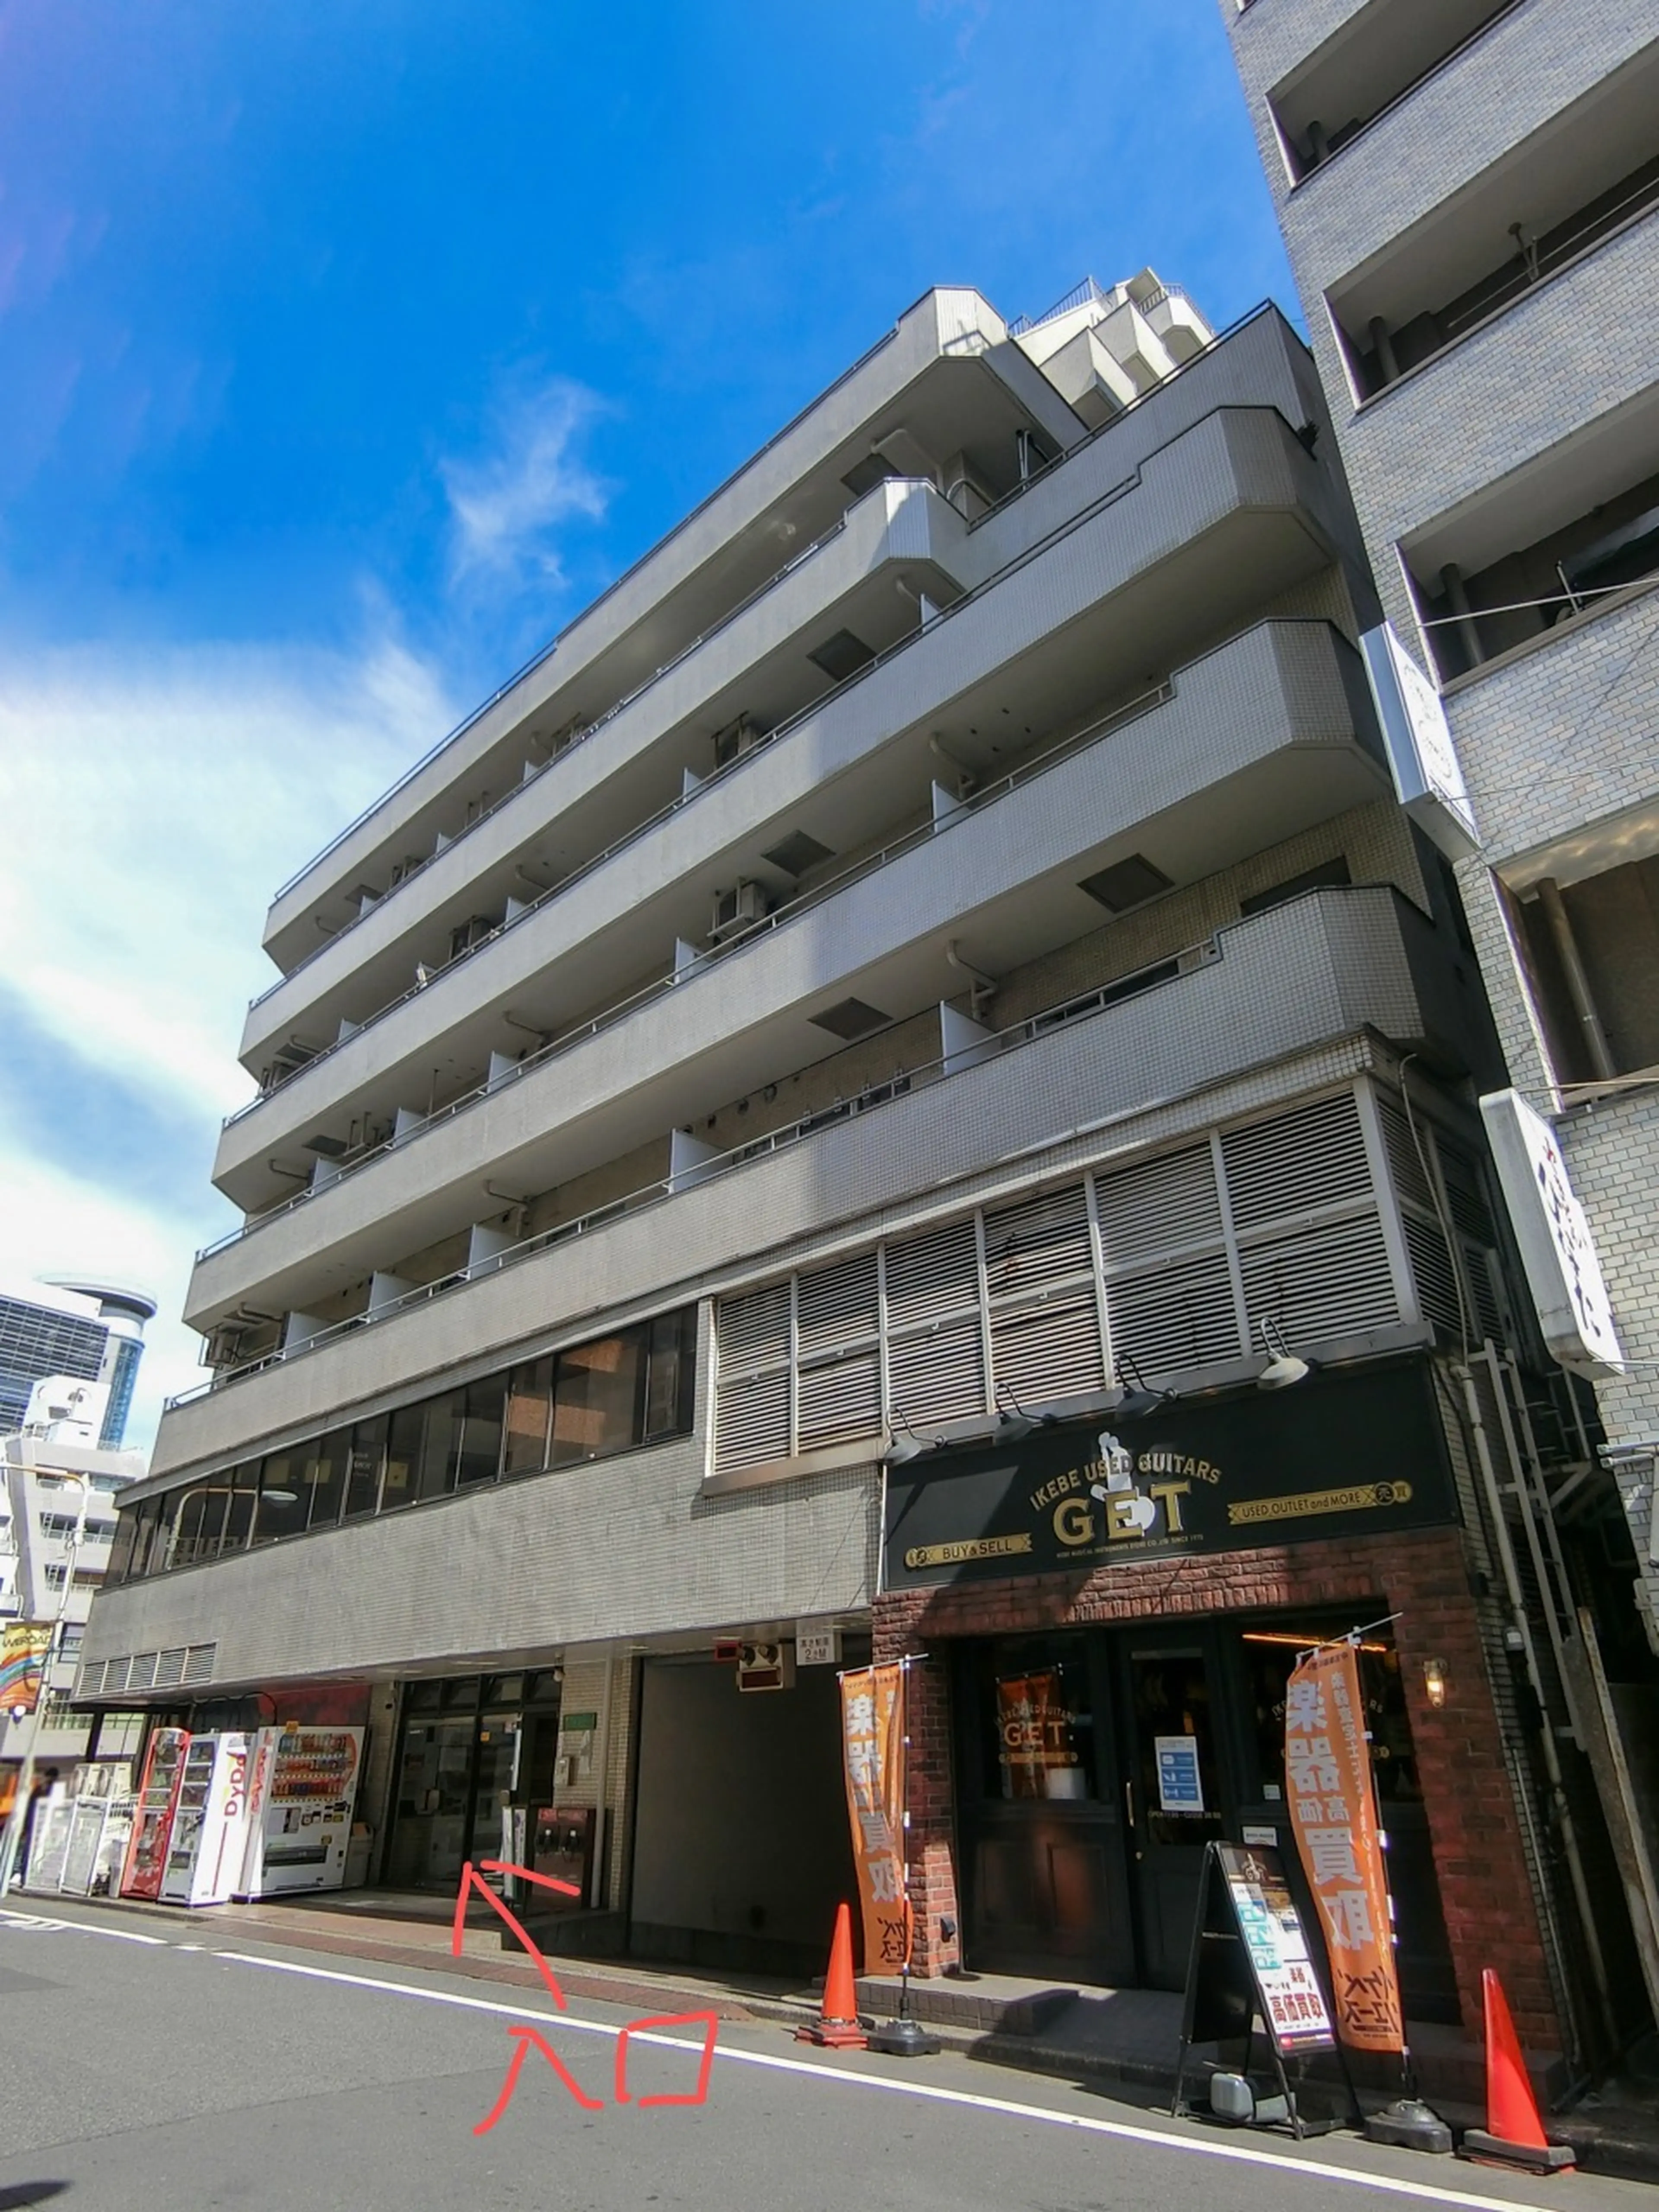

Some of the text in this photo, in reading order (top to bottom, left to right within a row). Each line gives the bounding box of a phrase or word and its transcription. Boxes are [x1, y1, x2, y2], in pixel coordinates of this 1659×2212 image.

[1030, 1452, 1222, 1511] IKEBE USED GUITARS
[1053, 1480, 1191, 1545] GET
[1243, 1505, 1268, 1518] USED
[1273, 1499, 1309, 1514] OUTLET
[1330, 1493, 1360, 1505] MORE
[1004, 1721, 1065, 1747] GET
[1269, 1991, 1324, 2023] 高価買取
